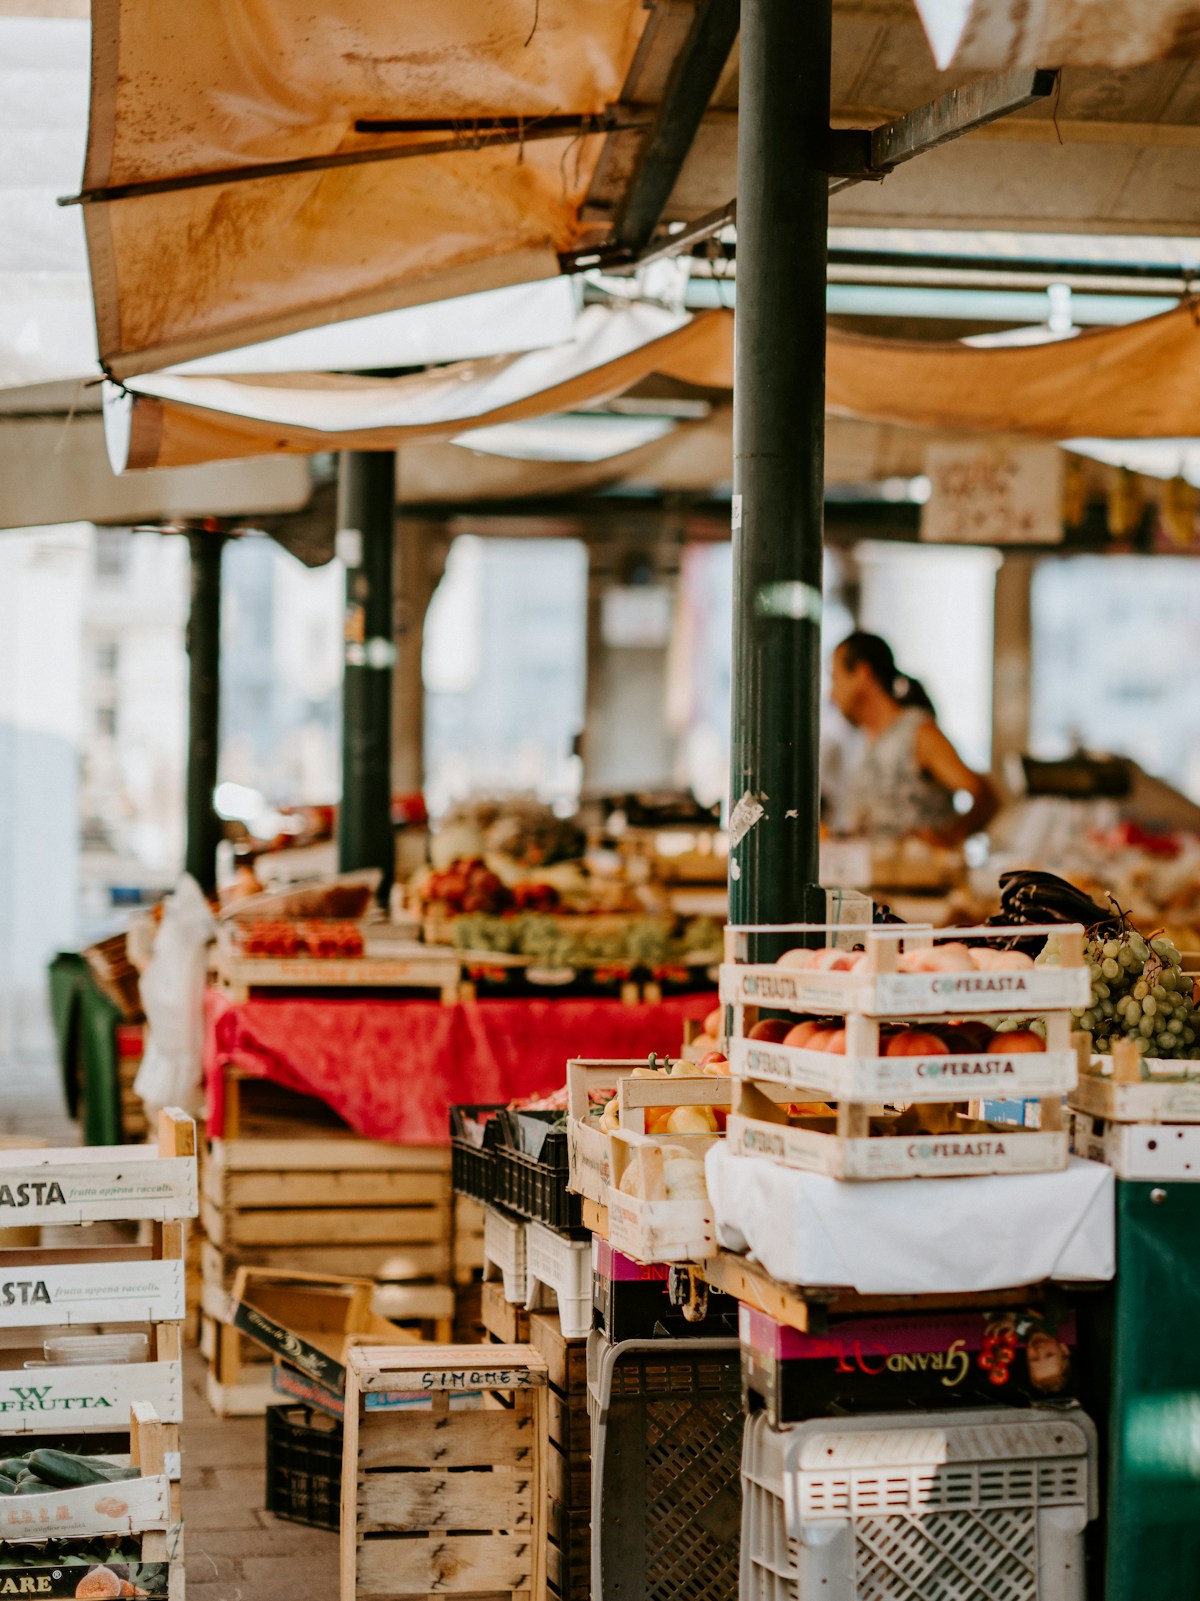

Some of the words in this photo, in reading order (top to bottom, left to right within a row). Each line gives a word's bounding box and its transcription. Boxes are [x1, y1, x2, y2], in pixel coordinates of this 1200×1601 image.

[930, 975, 1027, 995] COFERASTA
[916, 1060, 1015, 1078] COFERASTA
[907, 1142, 1006, 1160] COFERASTA
[0, 1182, 67, 1208] ASTA
[0, 1281, 52, 1307] STA
[0, 1397, 113, 1412] FRUTTA
